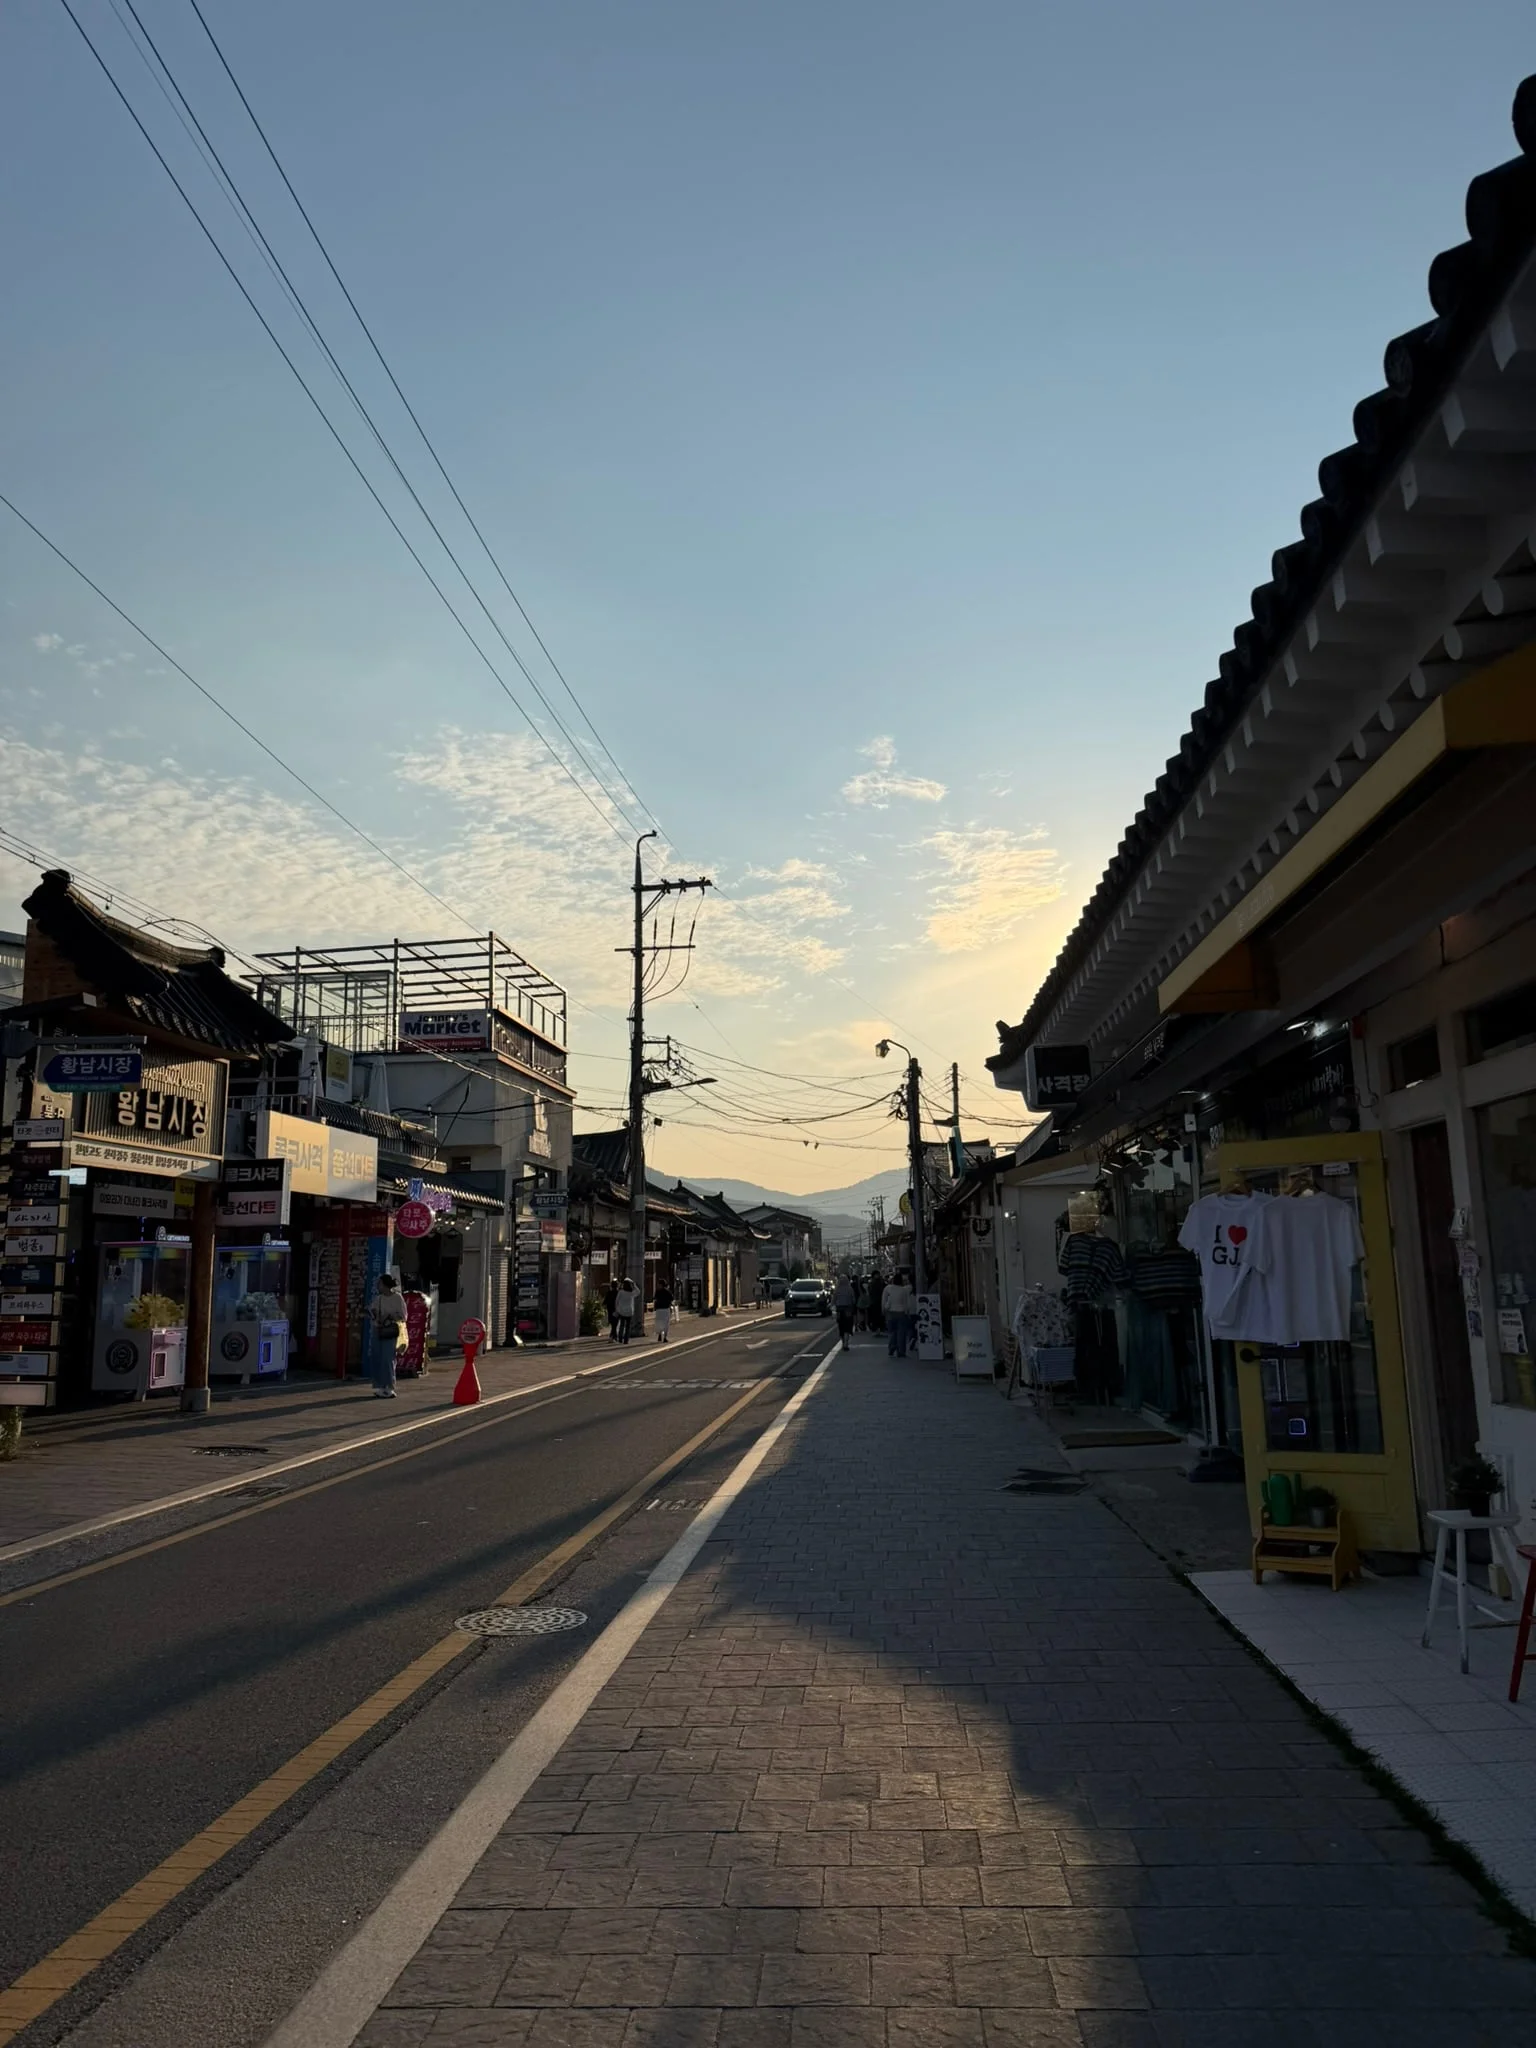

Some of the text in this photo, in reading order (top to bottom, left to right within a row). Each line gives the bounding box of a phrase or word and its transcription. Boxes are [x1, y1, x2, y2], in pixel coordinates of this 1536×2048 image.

[404, 1019, 482, 1035] Market
[61, 1056, 132, 1074] 황남시장
[224, 1166, 280, 1182] 콜크사격
[1215, 1225, 1222, 1243] I
